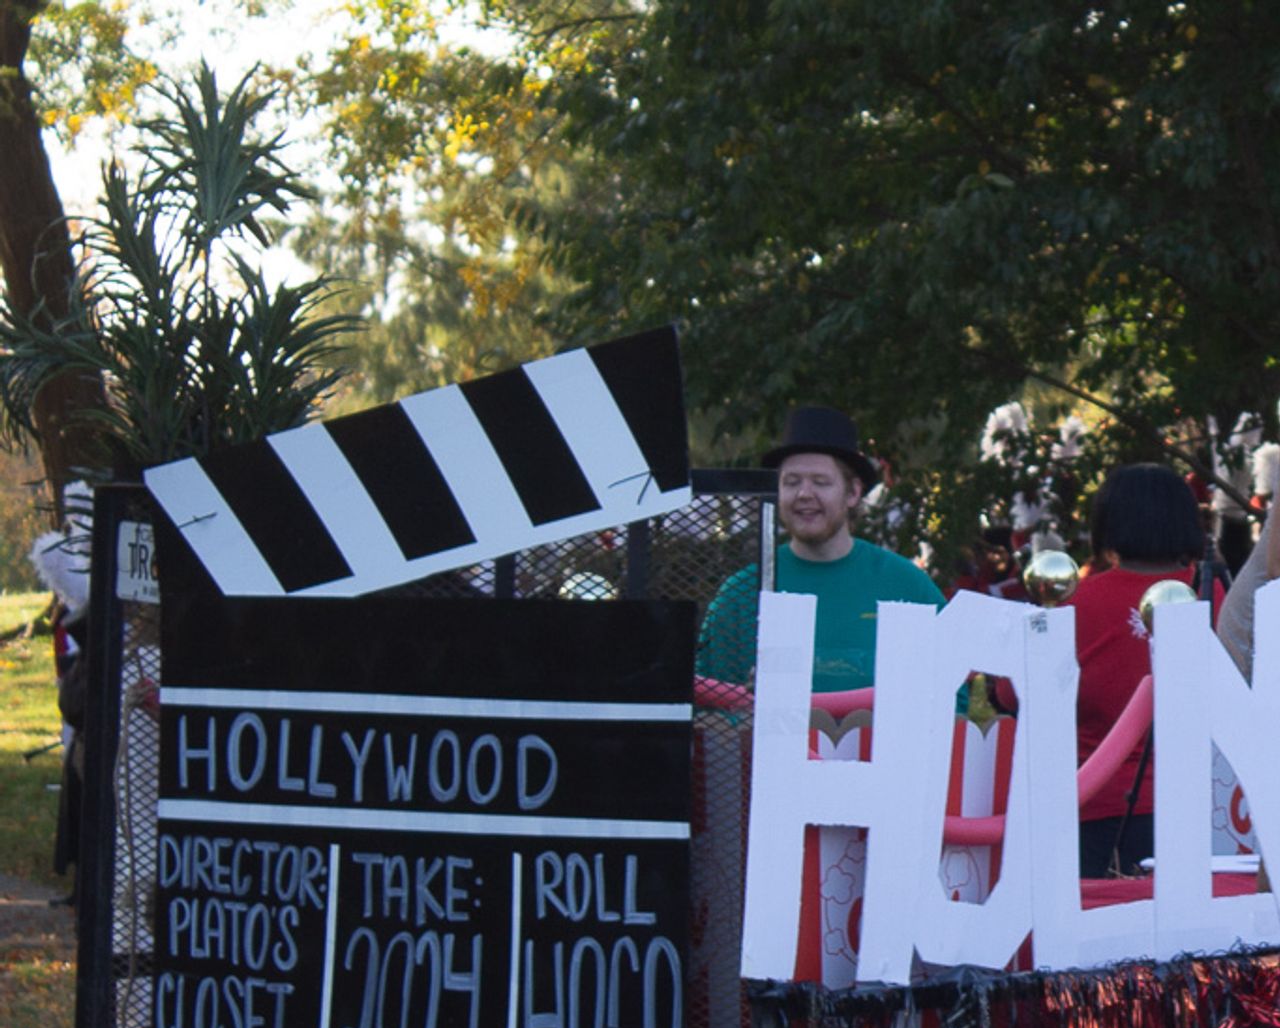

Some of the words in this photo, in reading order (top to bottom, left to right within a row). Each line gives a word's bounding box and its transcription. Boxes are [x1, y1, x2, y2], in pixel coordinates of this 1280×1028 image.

[178, 711, 559, 811] HOLLYWOOD
[159, 835, 329, 909] DIRECTOR:
[352, 852, 484, 927] TAKE:
[535, 850, 657, 926] ROLL
[168, 897, 300, 972] PLATO'S
